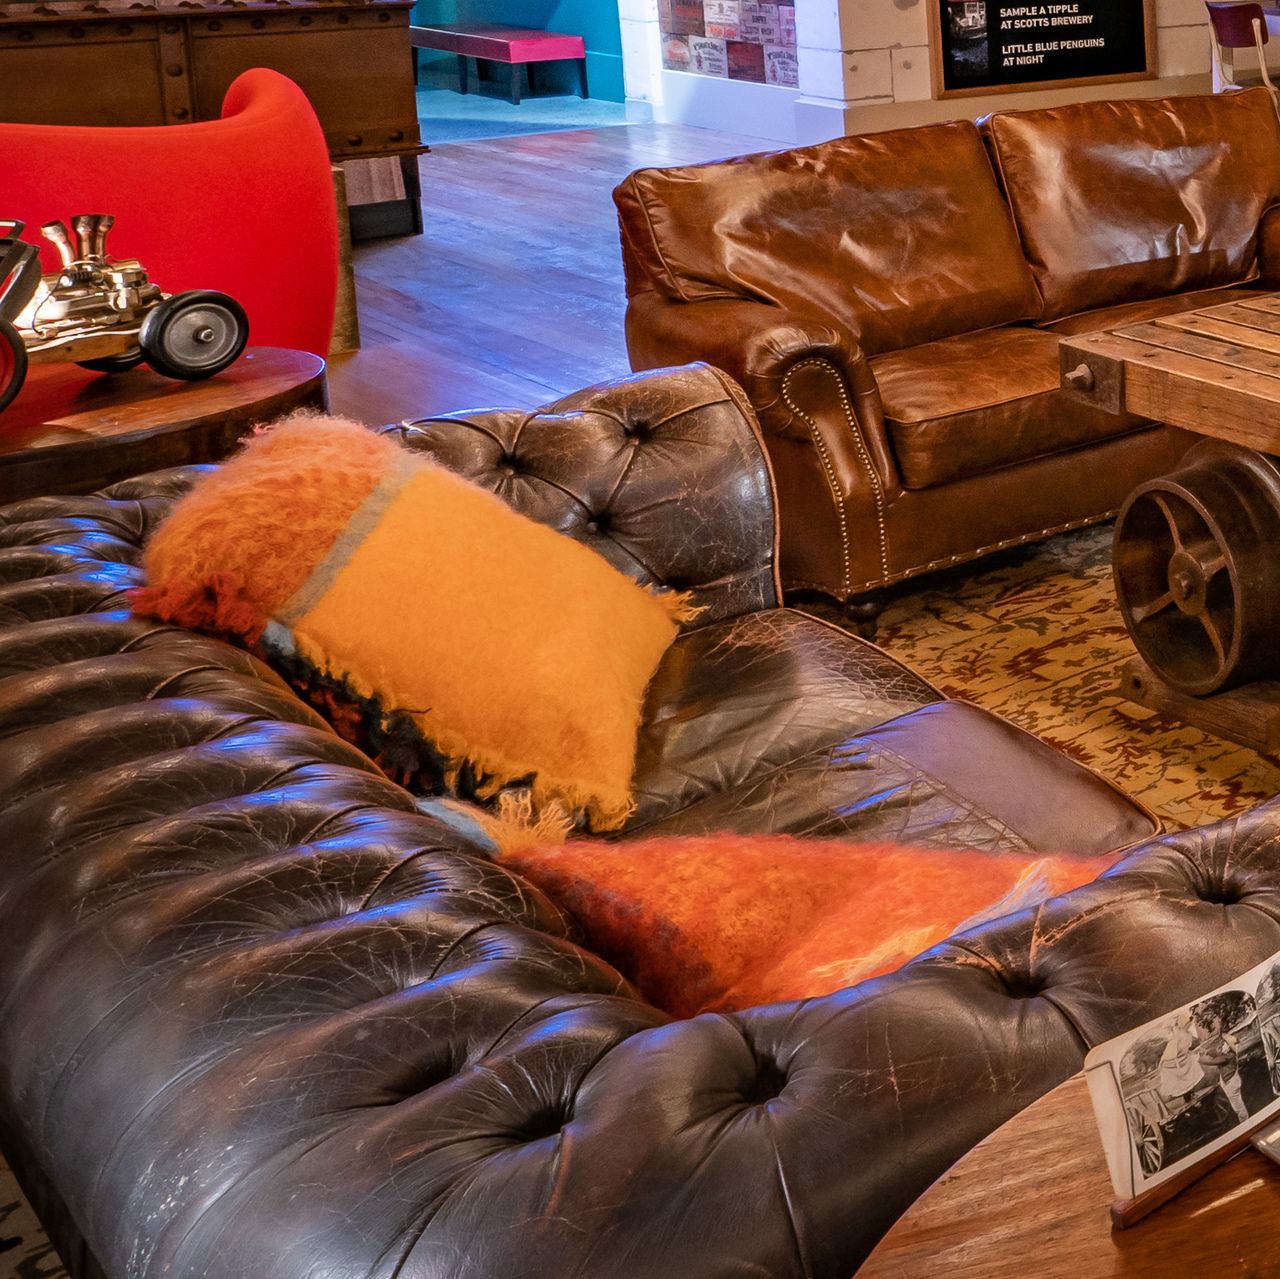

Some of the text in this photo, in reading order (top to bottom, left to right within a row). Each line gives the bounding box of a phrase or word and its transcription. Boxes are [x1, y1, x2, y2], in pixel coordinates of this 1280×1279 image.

[1000, 4, 1079, 17] SAMPLE A TIPPLE
[1000, 15, 1093, 29] AT SCOTTS BREWERY
[1002, 38, 1105, 54] LITTLE BLUE PENGUINS
[1003, 55, 1044, 66] AT NIGHT
